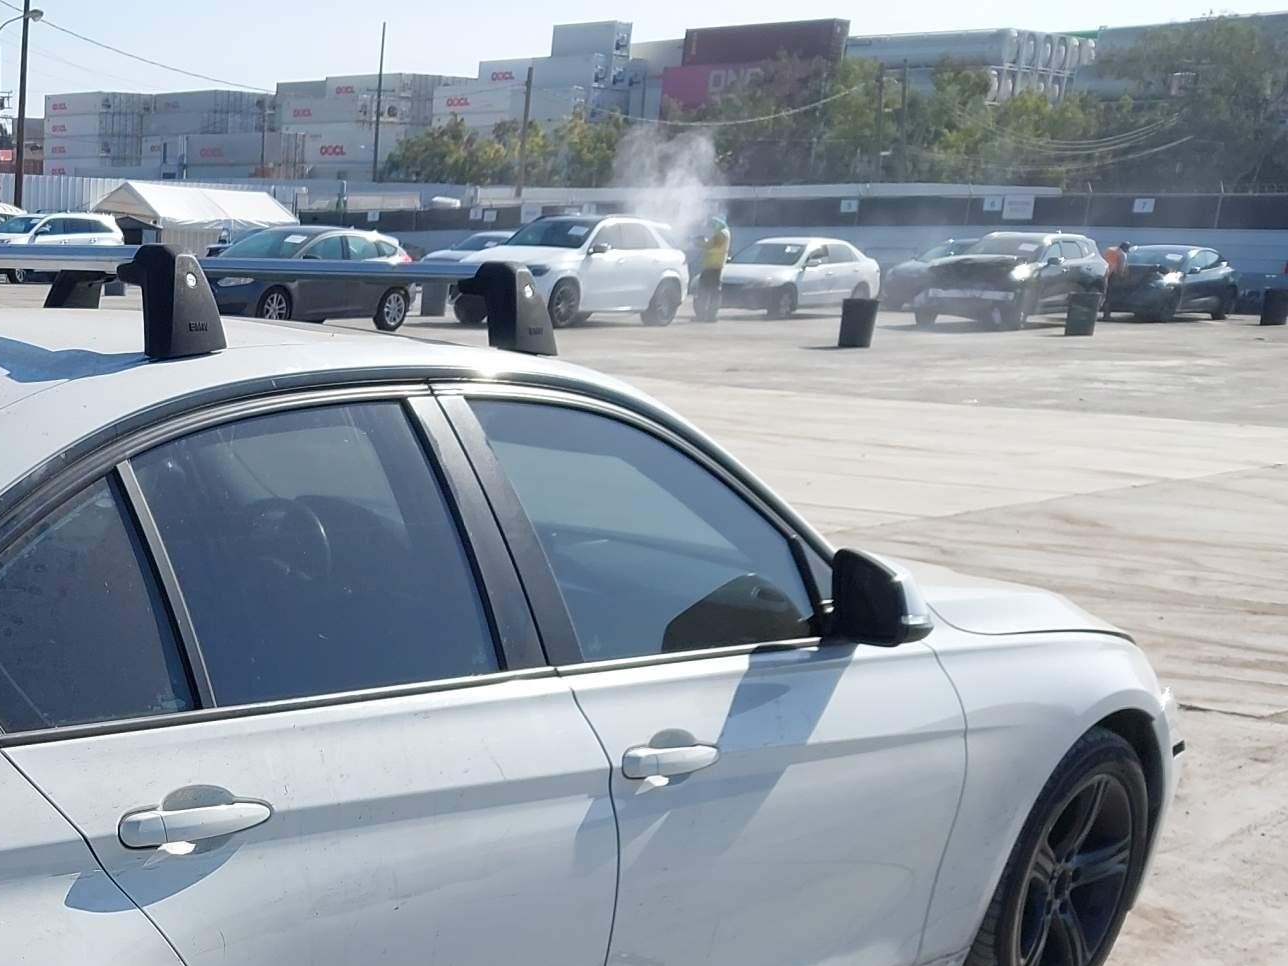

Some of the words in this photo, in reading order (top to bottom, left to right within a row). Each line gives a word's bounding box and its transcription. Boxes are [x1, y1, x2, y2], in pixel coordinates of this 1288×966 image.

[491, 71, 515, 81] OOCL
[446, 96, 470, 107] OOCL
[320, 145, 346, 156] OOCL
